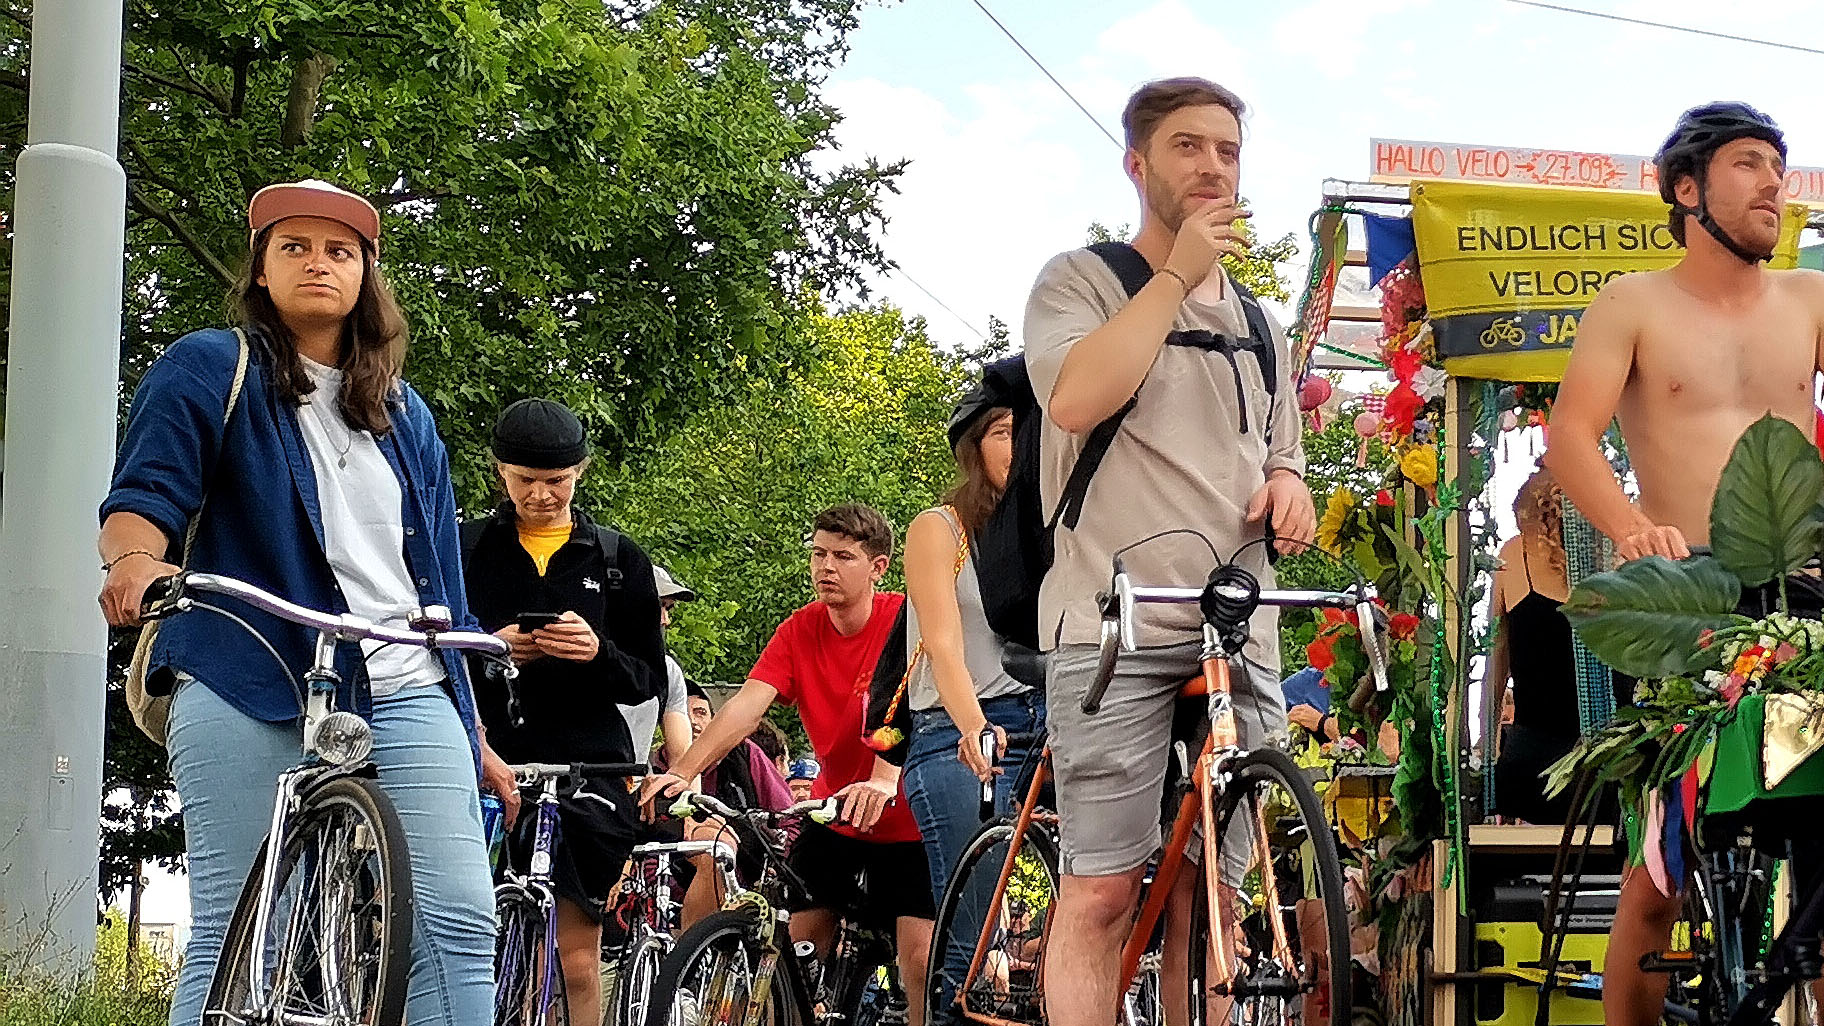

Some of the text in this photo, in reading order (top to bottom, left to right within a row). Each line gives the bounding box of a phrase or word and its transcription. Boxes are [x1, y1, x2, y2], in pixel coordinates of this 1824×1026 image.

[1376, 143, 1446, 178] HALLO
[1456, 148, 1511, 178] VELO
[1456, 222, 1678, 252] ENDLICH SIC
[1539, 314, 1579, 345] JA
